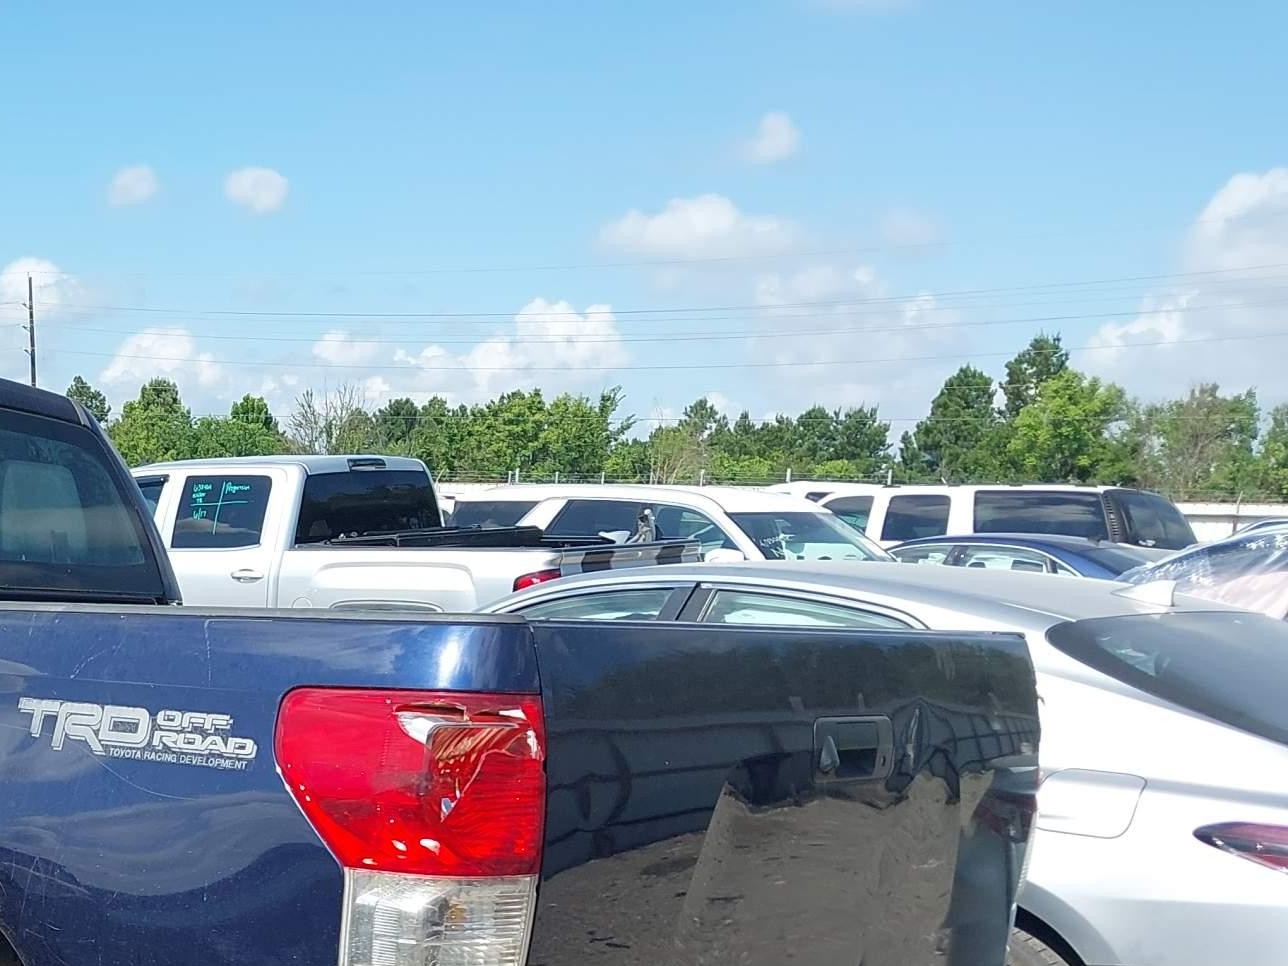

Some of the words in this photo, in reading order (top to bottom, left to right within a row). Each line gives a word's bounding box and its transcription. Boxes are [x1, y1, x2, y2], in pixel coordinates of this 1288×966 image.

[18, 697, 150, 756] TRD
[156, 710, 233, 733] OFF
[152, 731, 258, 759] ROAD
[109, 748, 141, 759] TOYOTA
[143, 751, 177, 763] RACING
[179, 754, 248, 770] DEVELOPMENT
